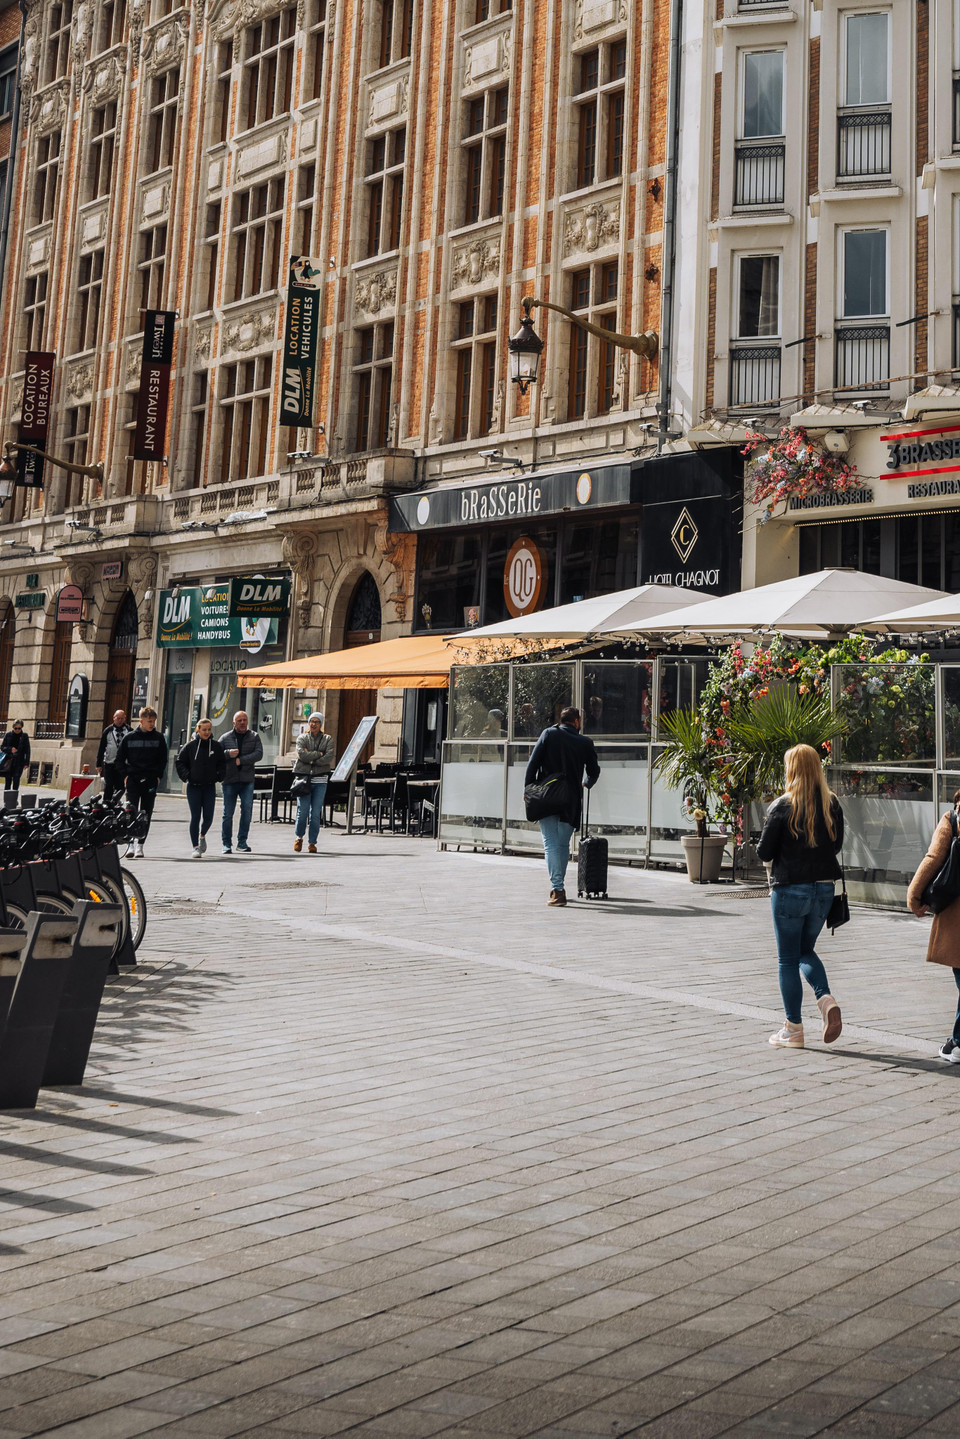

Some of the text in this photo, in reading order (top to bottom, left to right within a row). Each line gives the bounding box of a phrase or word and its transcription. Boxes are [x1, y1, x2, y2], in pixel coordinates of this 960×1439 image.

[288, 298, 301, 355] LOCATION
[300, 296, 313, 359] VEHICULES
[23, 364, 38, 428] LOCATION
[37, 369, 50, 425] BUREAUX
[144, 370, 161, 451] RESTAURANT
[283, 367, 300, 414] DLM
[680, 524, 690, 545] C
[240, 584, 282, 601] DLM
[513, 558, 533, 602] QG
[675, 569, 720, 587] CHAGNOT
[162, 595, 191, 624] DLM
[200, 617, 229, 628] CAMIONS
[197, 630, 231, 640] HANDYBUS
